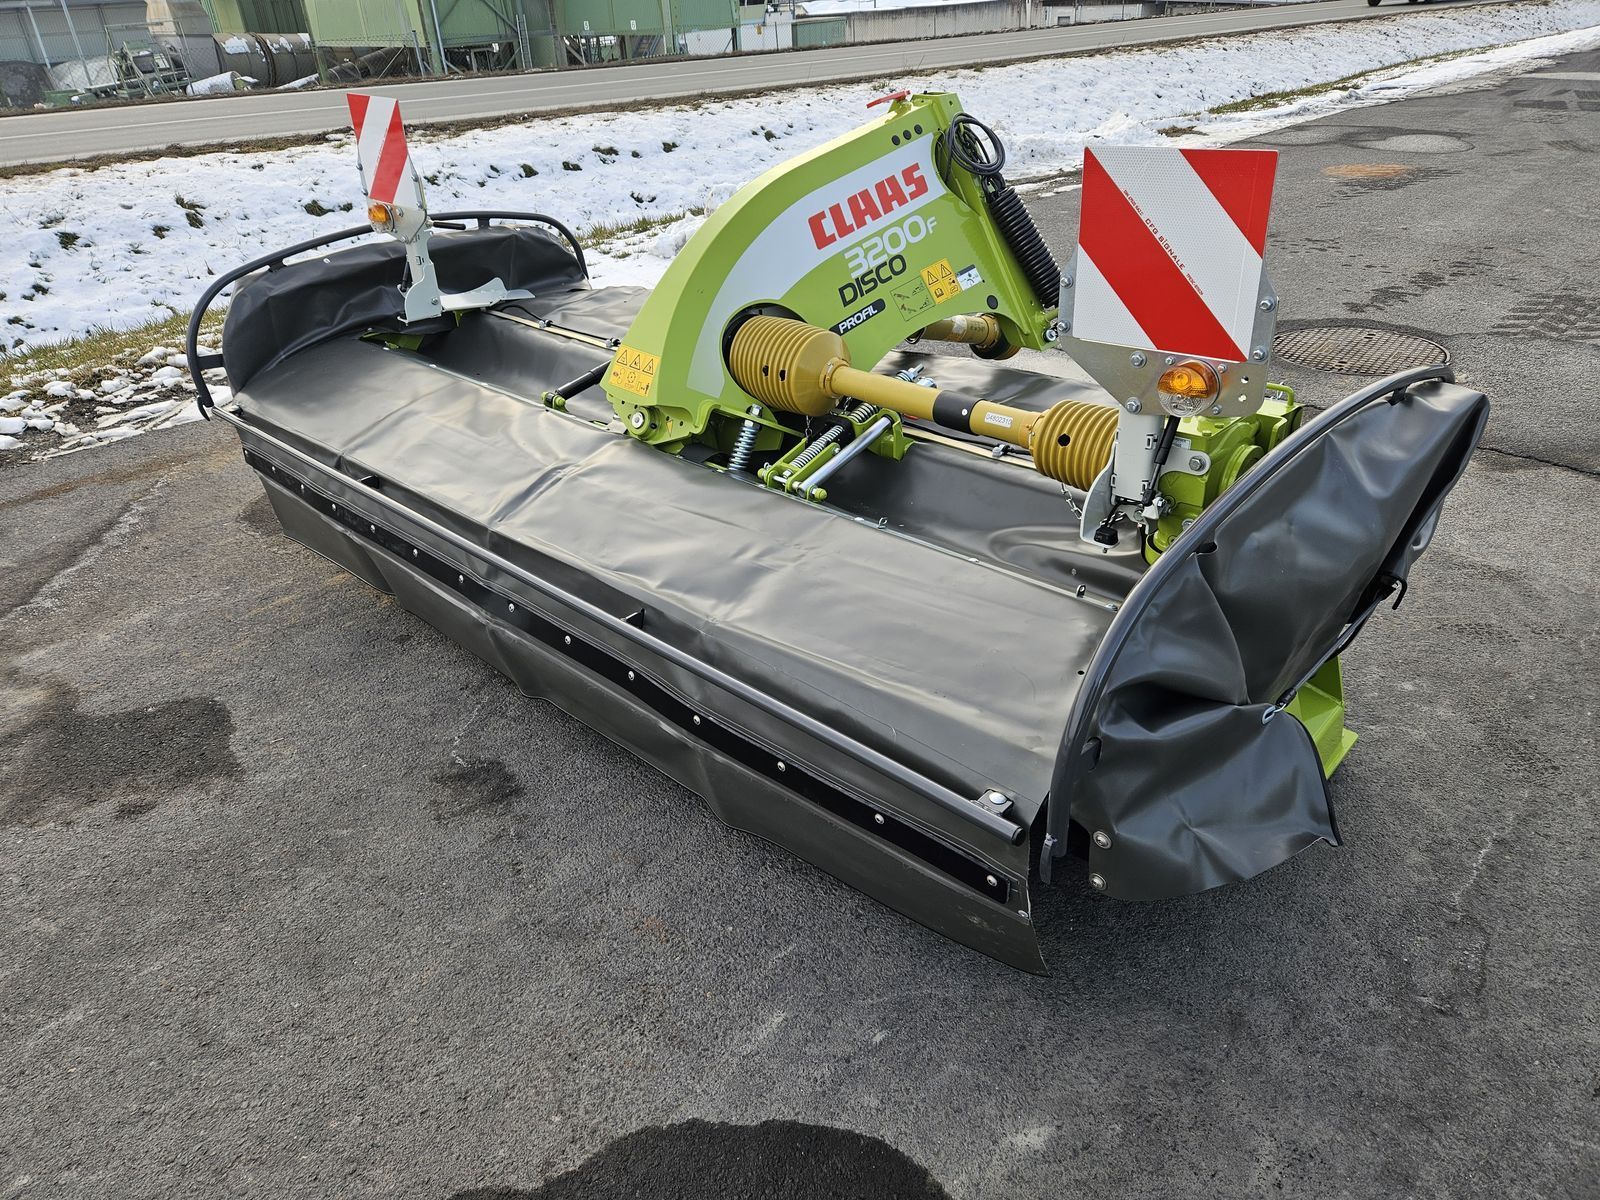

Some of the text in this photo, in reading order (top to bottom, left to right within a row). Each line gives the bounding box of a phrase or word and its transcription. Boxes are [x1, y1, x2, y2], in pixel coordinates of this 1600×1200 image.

[808, 162, 928, 250] CLAAS
[838, 254, 907, 308] DISCO
[838, 304, 878, 334] PROFIL
